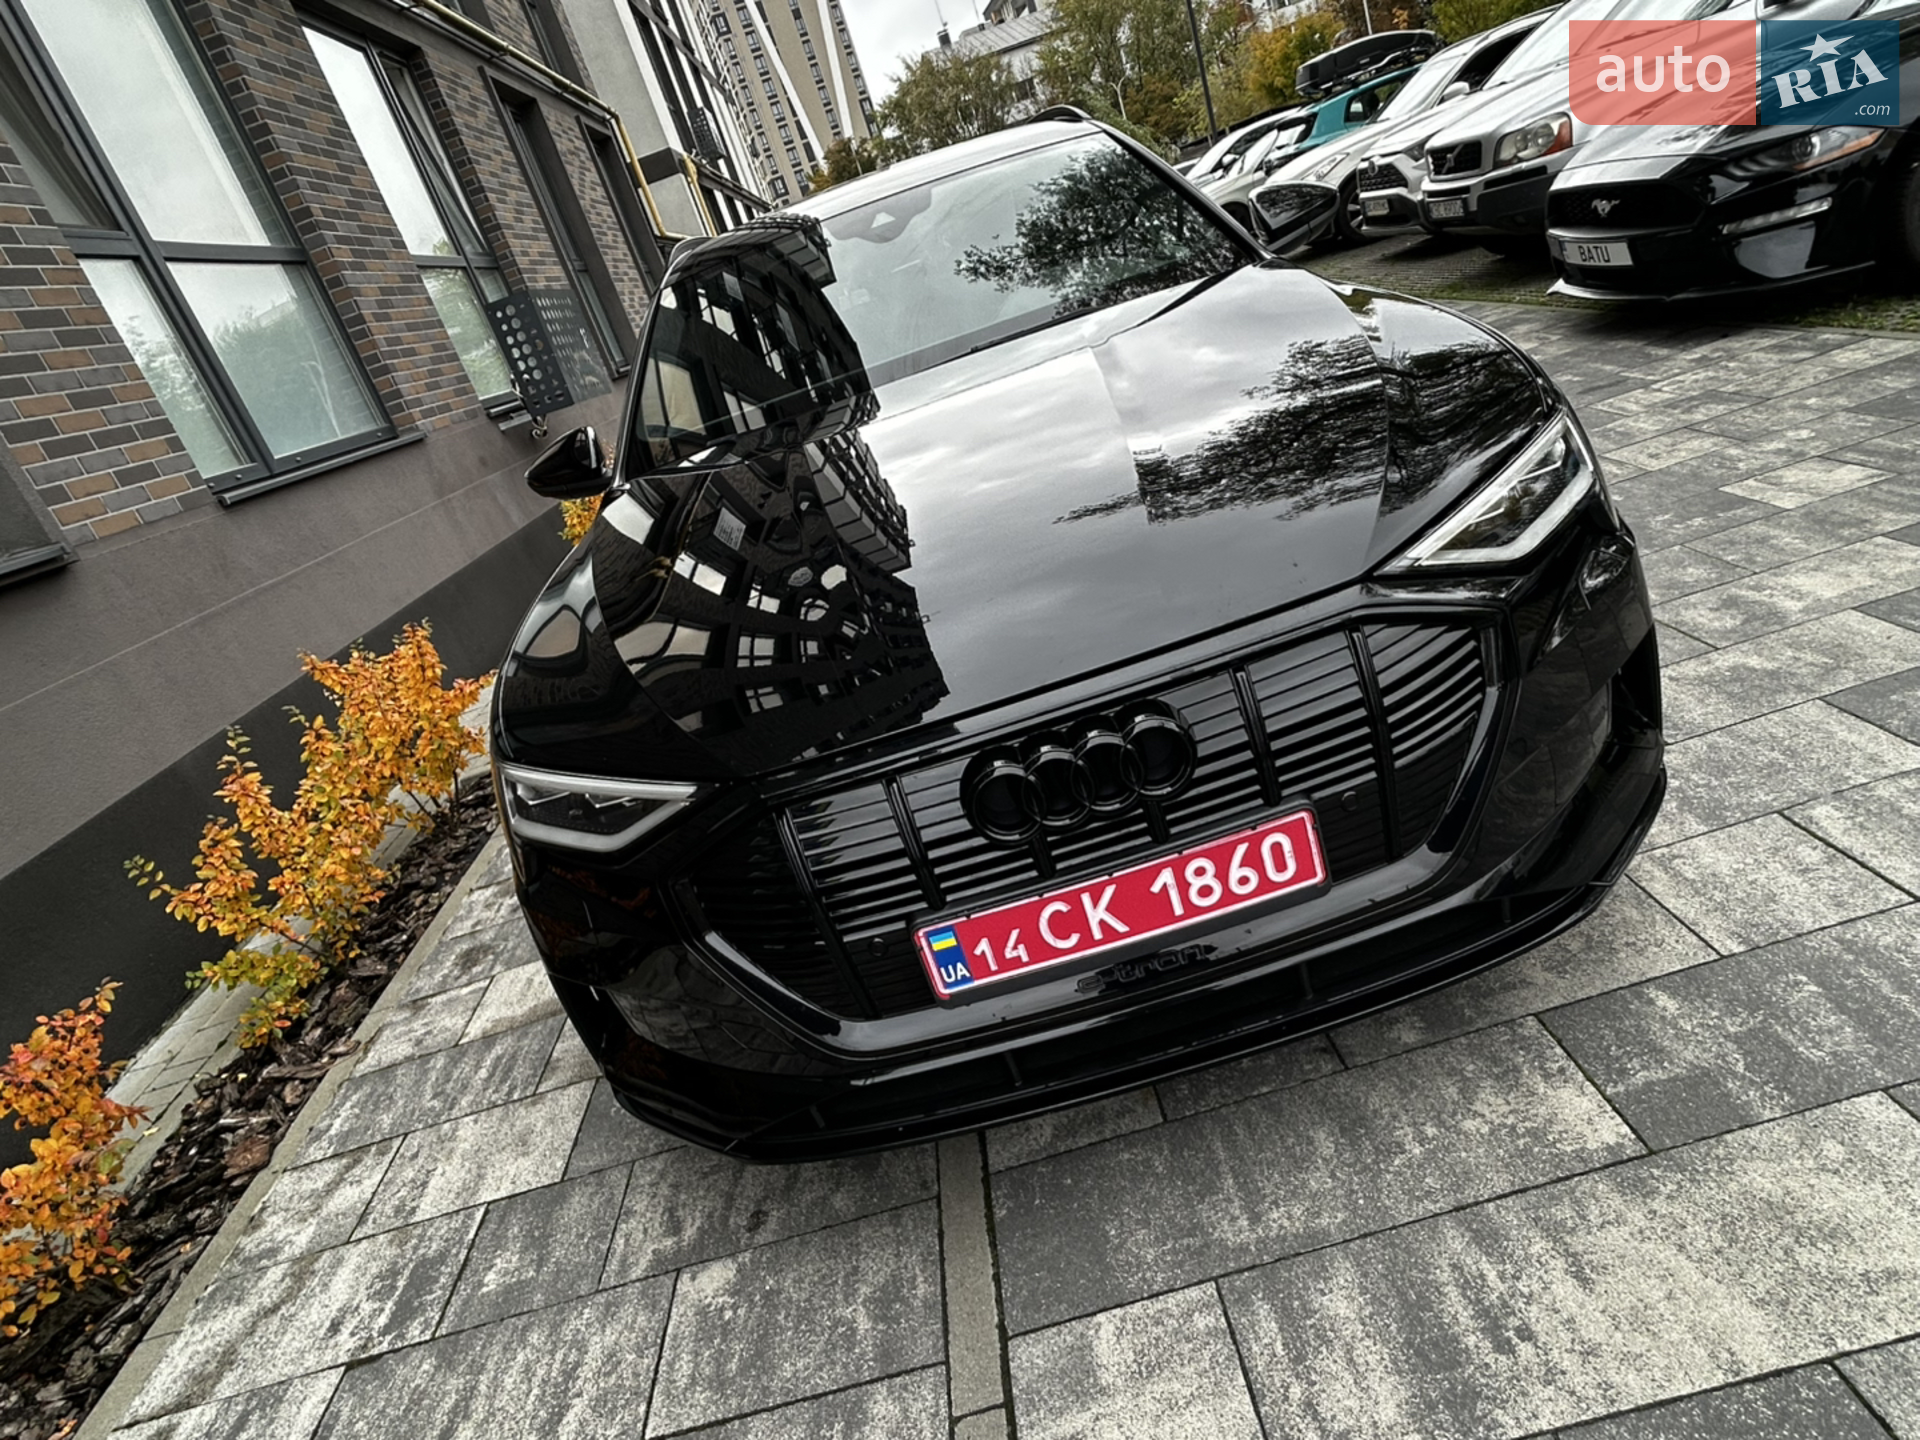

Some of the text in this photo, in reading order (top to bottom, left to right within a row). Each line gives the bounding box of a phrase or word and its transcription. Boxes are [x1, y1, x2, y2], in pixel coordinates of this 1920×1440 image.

[1578, 245, 1611, 263] BATU
[973, 928, 1030, 973] 14
[1149, 832, 1297, 917] 1860
[940, 962, 971, 984] UA
[1077, 944, 1206, 993] e-tron
